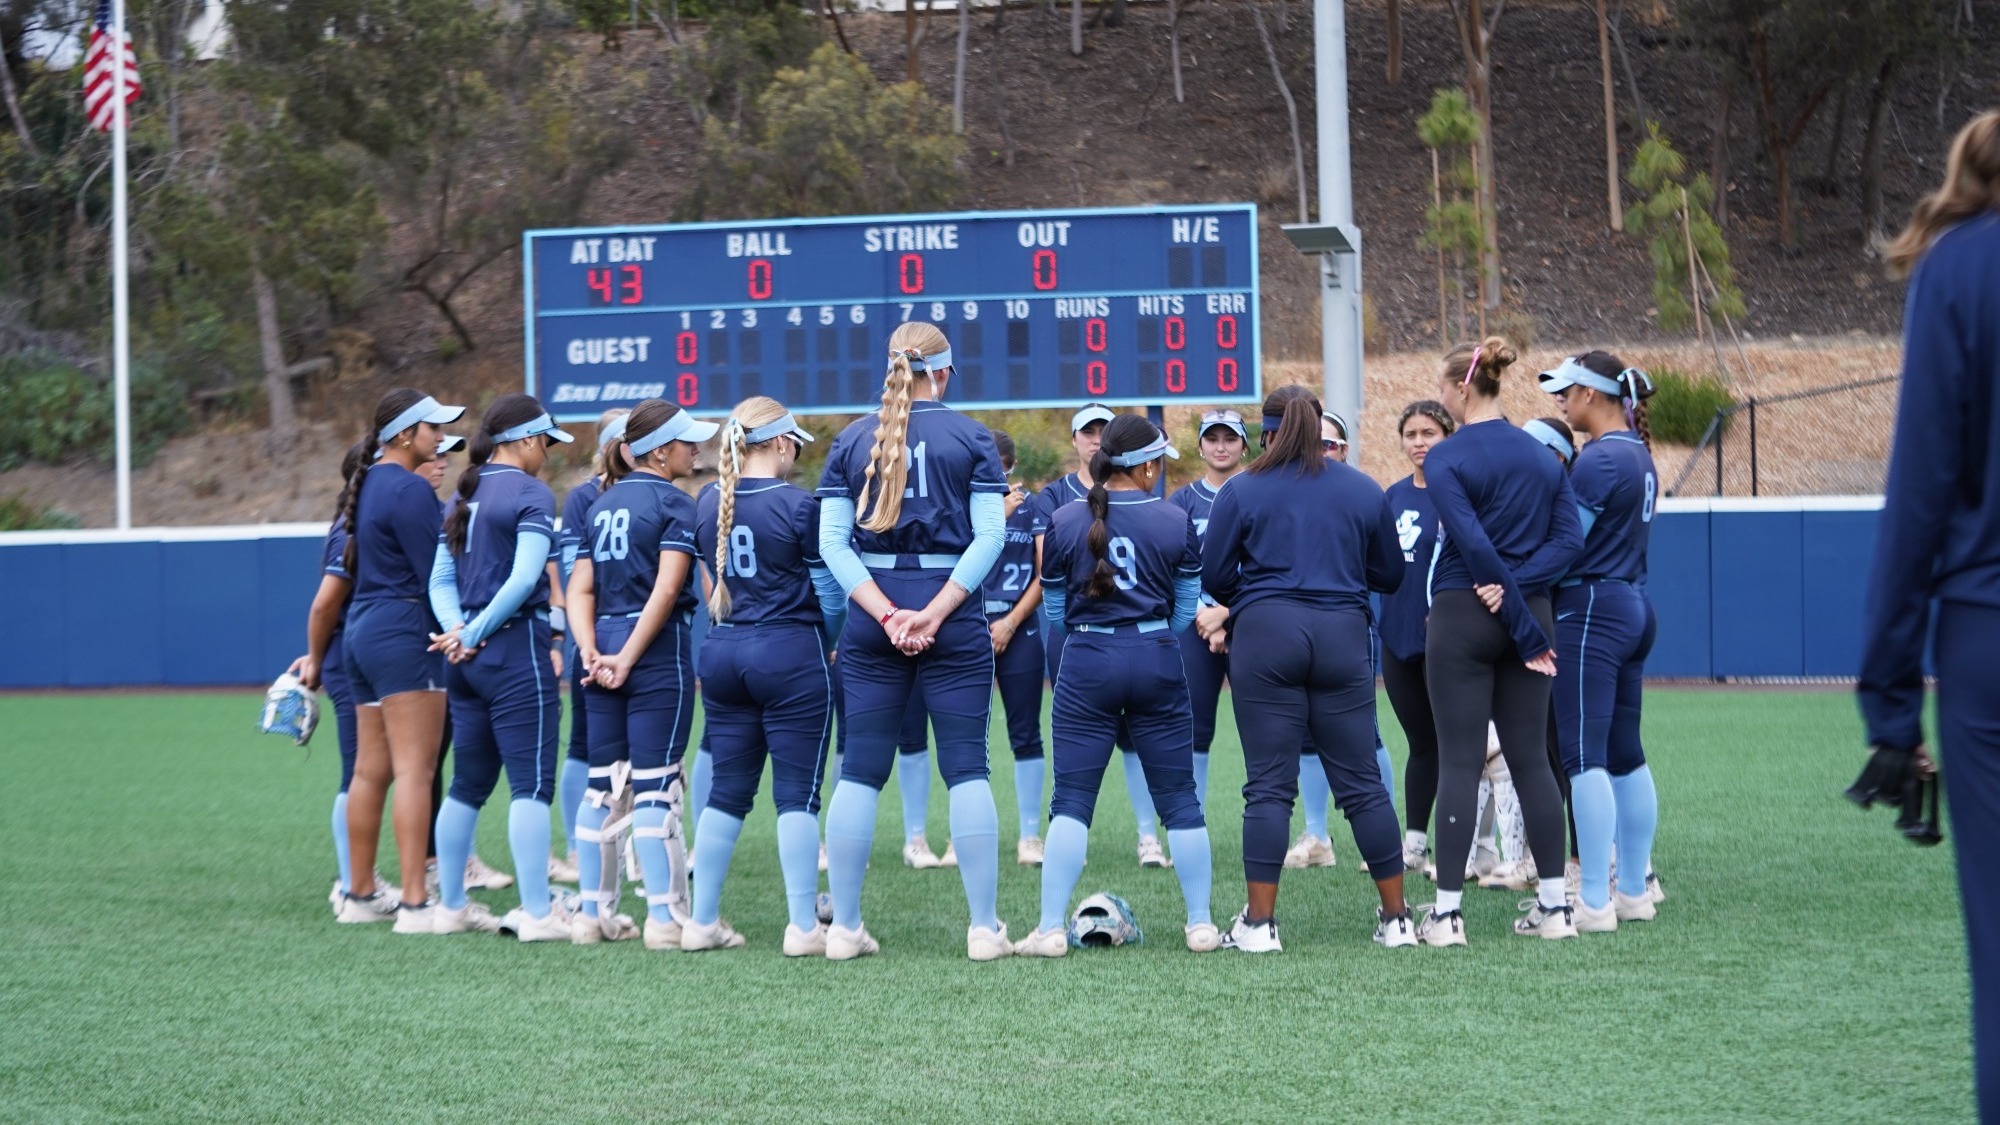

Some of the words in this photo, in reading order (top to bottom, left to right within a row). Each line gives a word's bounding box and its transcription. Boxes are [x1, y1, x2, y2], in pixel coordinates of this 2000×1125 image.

[727, 232, 792, 257] BALL
[865, 225, 959, 253] STRIKE
[1018, 222, 1071, 247] OUT
[1172, 217, 1220, 243] H/E
[571, 240, 602, 264] AT
[608, 238, 657, 262] BAT
[1033, 249, 1057, 290] 0
[587, 264, 643, 304] 43
[748, 259, 772, 299] 0
[899, 253, 924, 294] 0
[680, 312, 691, 330] 1
[710, 310, 726, 329] 2
[741, 309, 758, 328] 3
[786, 307, 802, 326] 4
[818, 305, 835, 325] 5
[850, 304, 866, 324] 6
[899, 303, 914, 322] 7
[930, 302, 947, 321] 8
[962, 301, 979, 320] 9
[1005, 299, 1030, 319] 10
[1055, 298, 1110, 317] RUNS
[1138, 295, 1185, 315] HITS
[1206, 294, 1247, 314] ERR
[567, 336, 651, 365] GUEST
[676, 331, 698, 365] 0
[1085, 318, 1107, 352] 0
[1165, 316, 1185, 350] 0
[1216, 315, 1237, 349] 0
[677, 372, 698, 406] 0
[1086, 360, 1107, 395] 0
[1165, 359, 1186, 393] 0
[1217, 357, 1238, 392] 0
[1642, 472, 1655, 522] 8
[594, 508, 630, 562] 28
[1004, 531, 1034, 544] EROS
[1003, 563, 1032, 591] 27
[1108, 536, 1138, 590] 9
